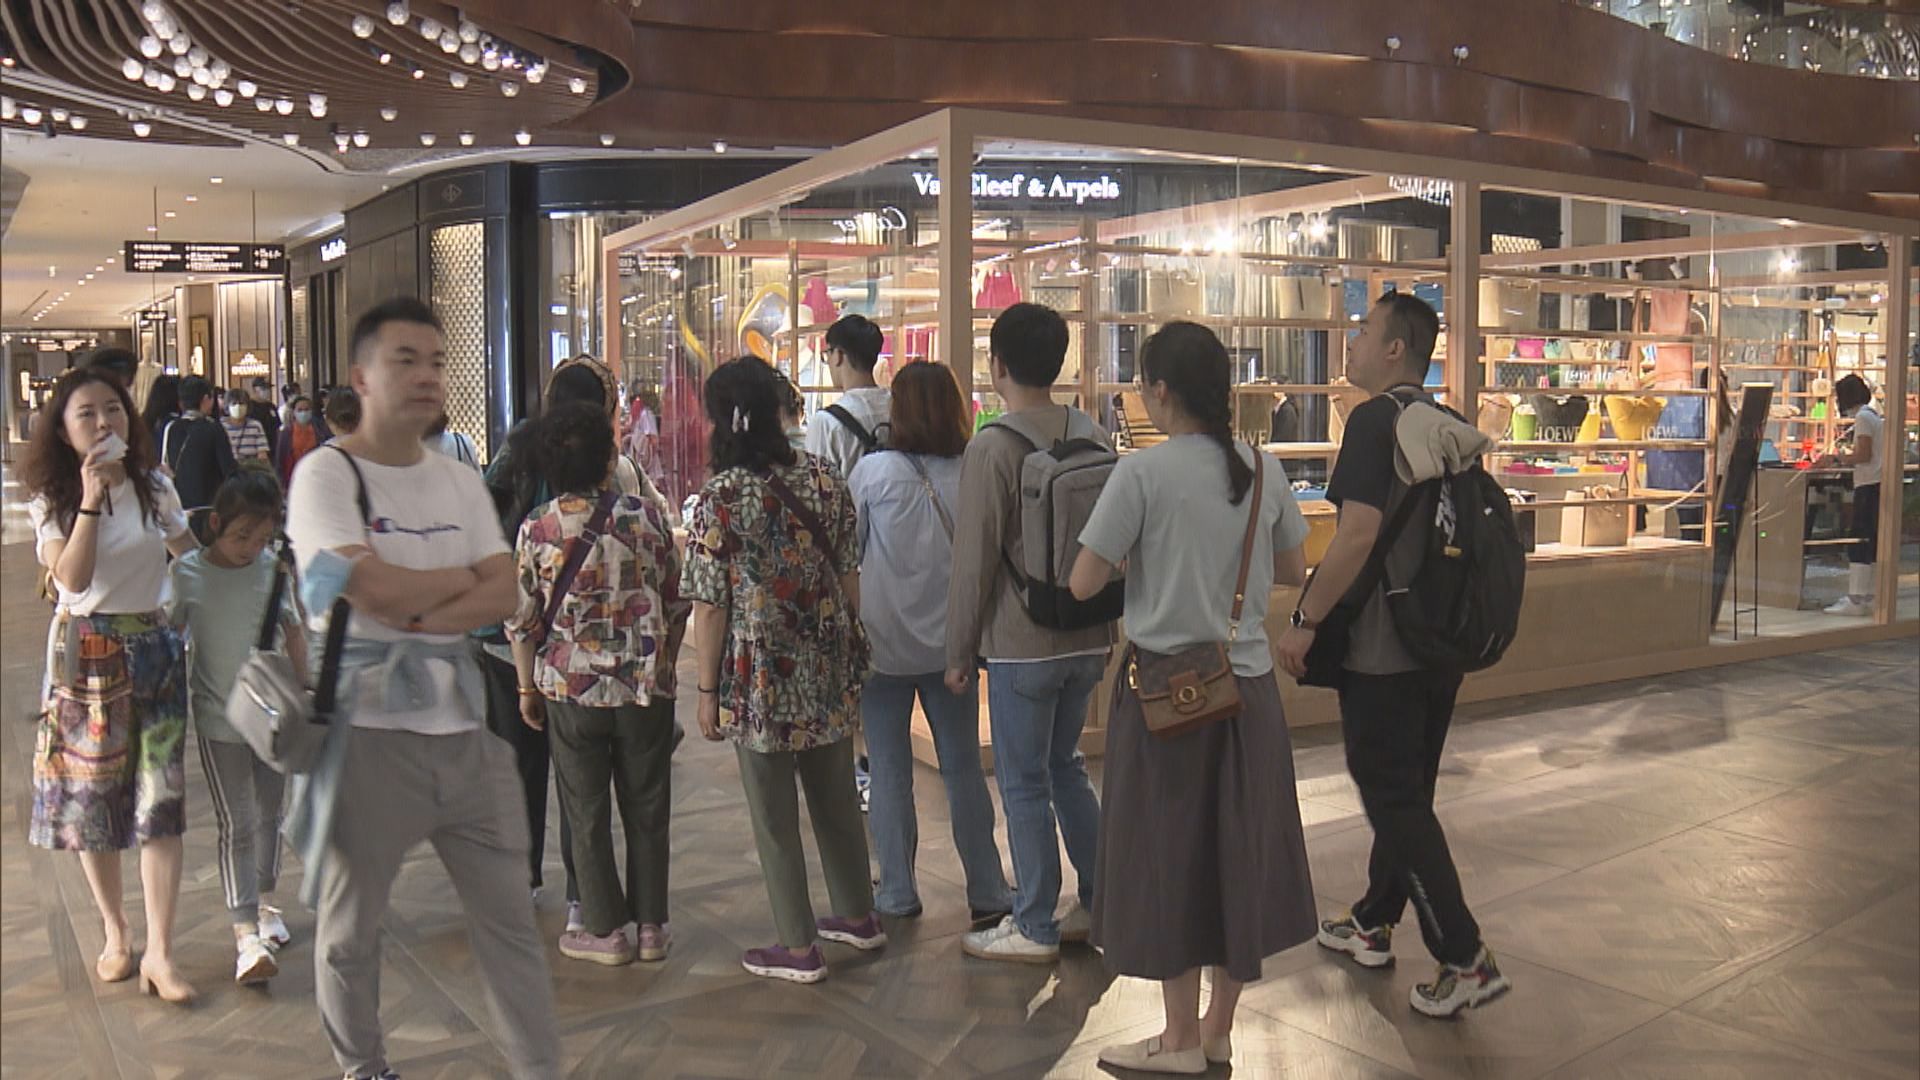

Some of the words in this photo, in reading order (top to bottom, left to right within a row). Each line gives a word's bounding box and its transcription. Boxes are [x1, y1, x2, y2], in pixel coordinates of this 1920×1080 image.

[912, 171, 941, 196] Va
[1028, 177, 1046, 198] &
[1049, 173, 1120, 206] Arpels
